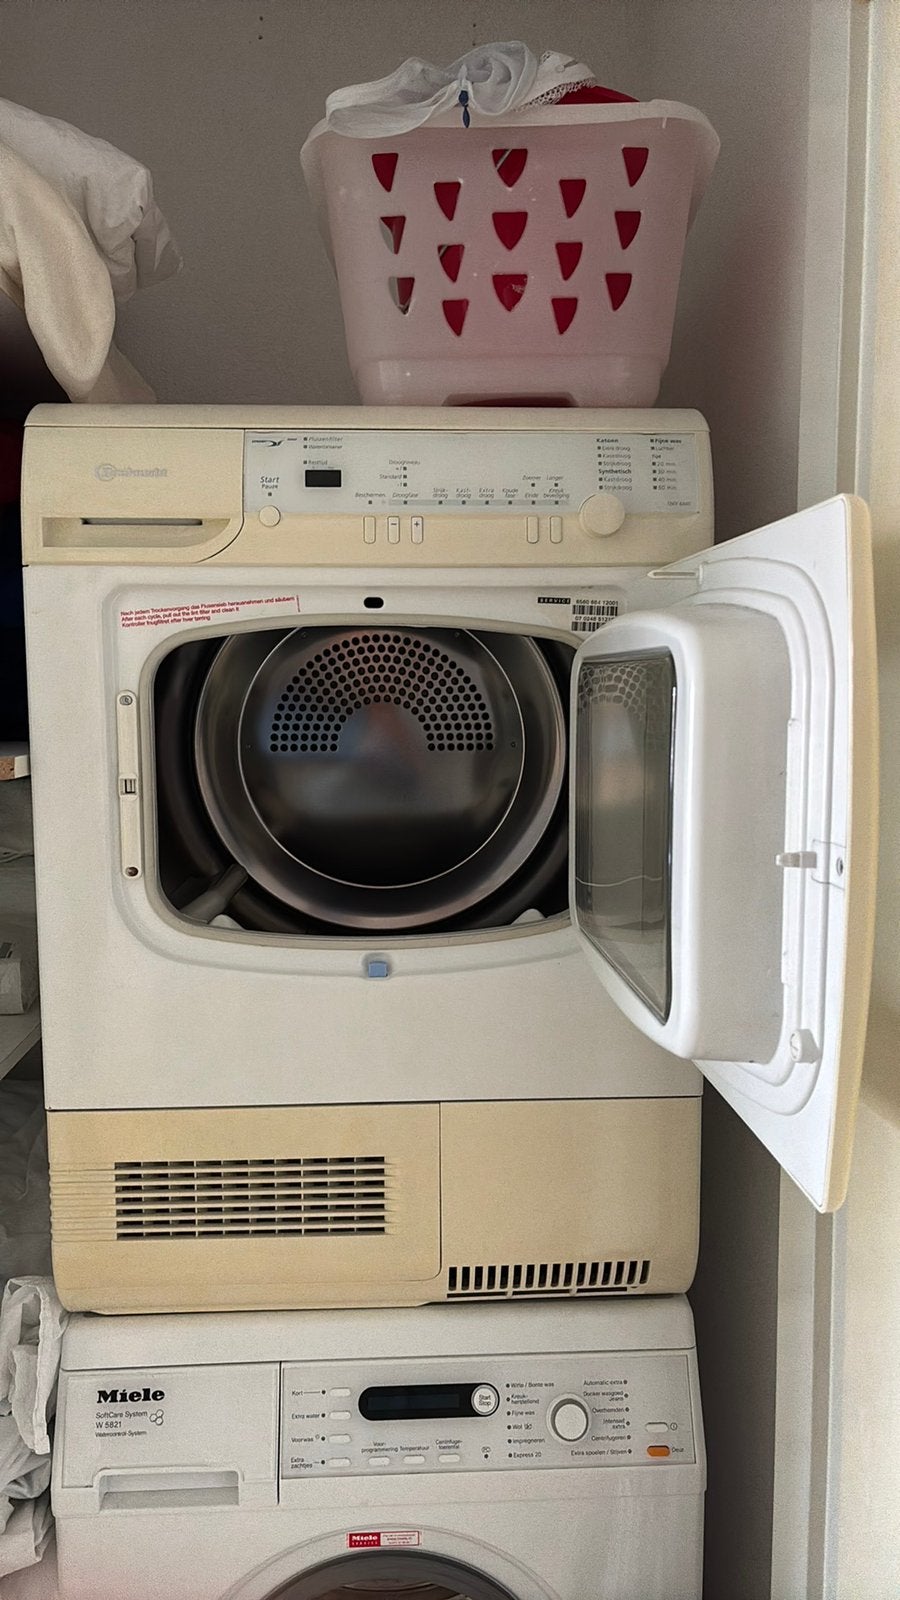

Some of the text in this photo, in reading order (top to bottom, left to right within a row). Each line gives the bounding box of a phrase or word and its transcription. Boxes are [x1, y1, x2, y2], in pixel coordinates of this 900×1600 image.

[97, 1388, 165, 1403] Miele
[96, 1410, 148, 1419] SoftCare System
